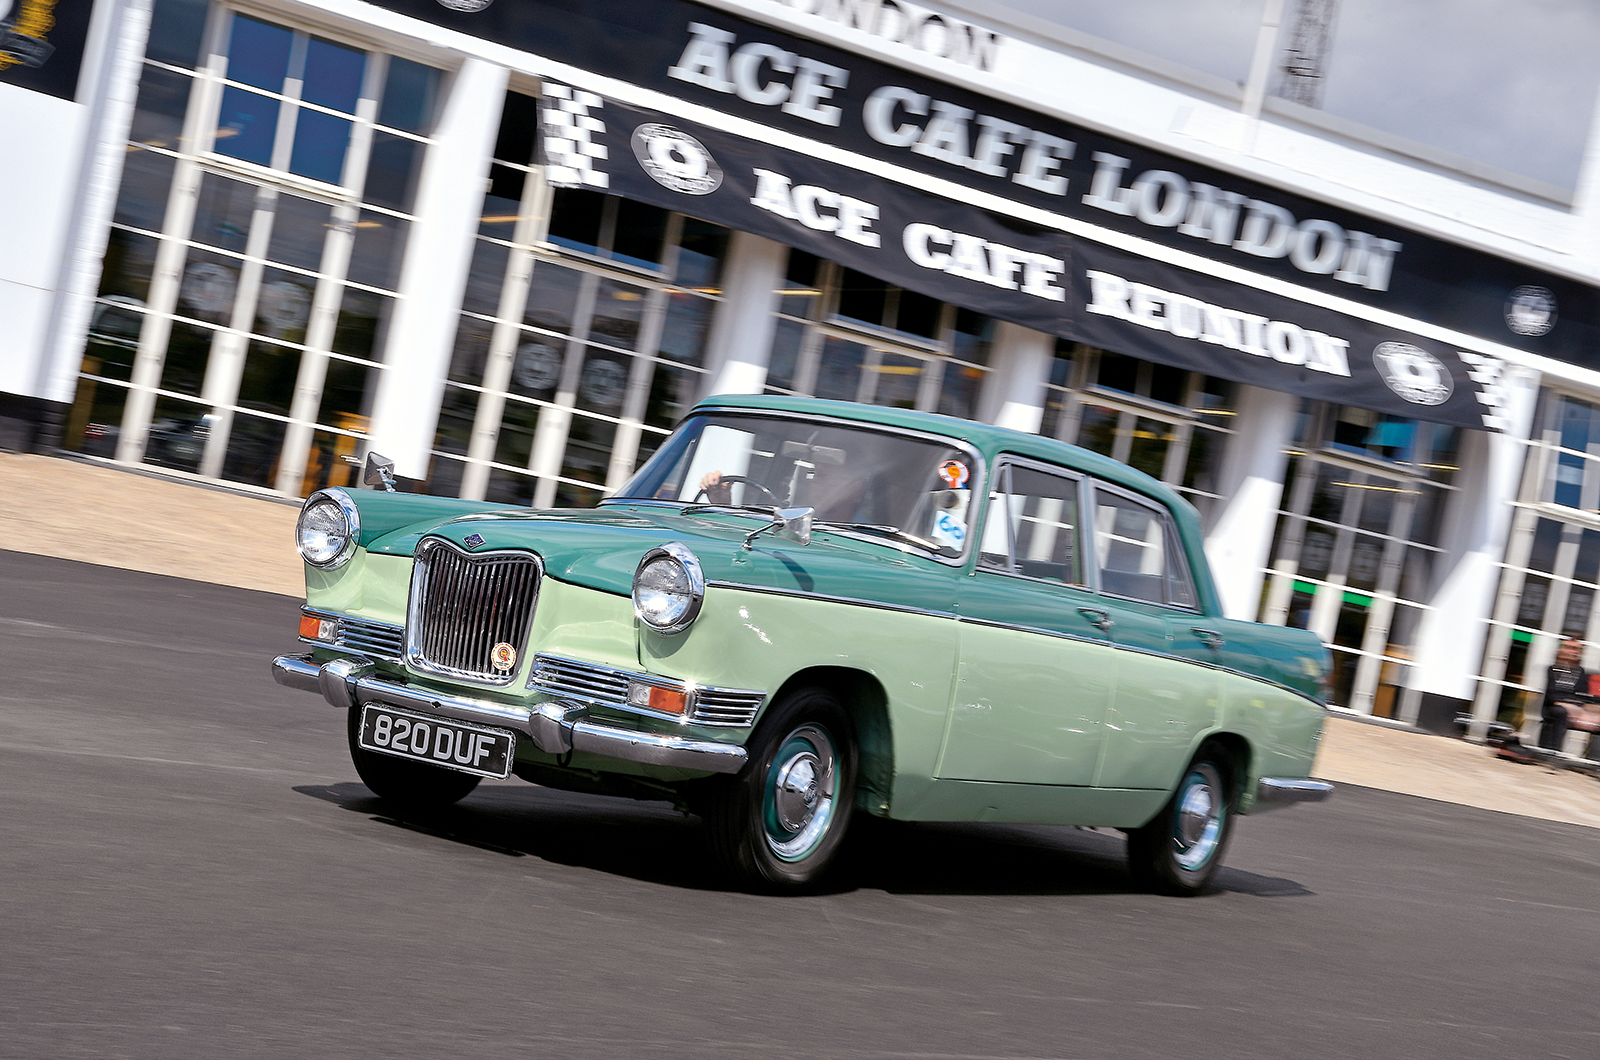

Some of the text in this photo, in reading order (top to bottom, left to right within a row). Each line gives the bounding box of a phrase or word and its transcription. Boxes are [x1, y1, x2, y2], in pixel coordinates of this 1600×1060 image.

[667, 22, 1402, 291] ACE CAFE LONDON
[750, 168, 1351, 377] ACE CAFE REUNION
[373, 714, 496, 767] 820 DUF
